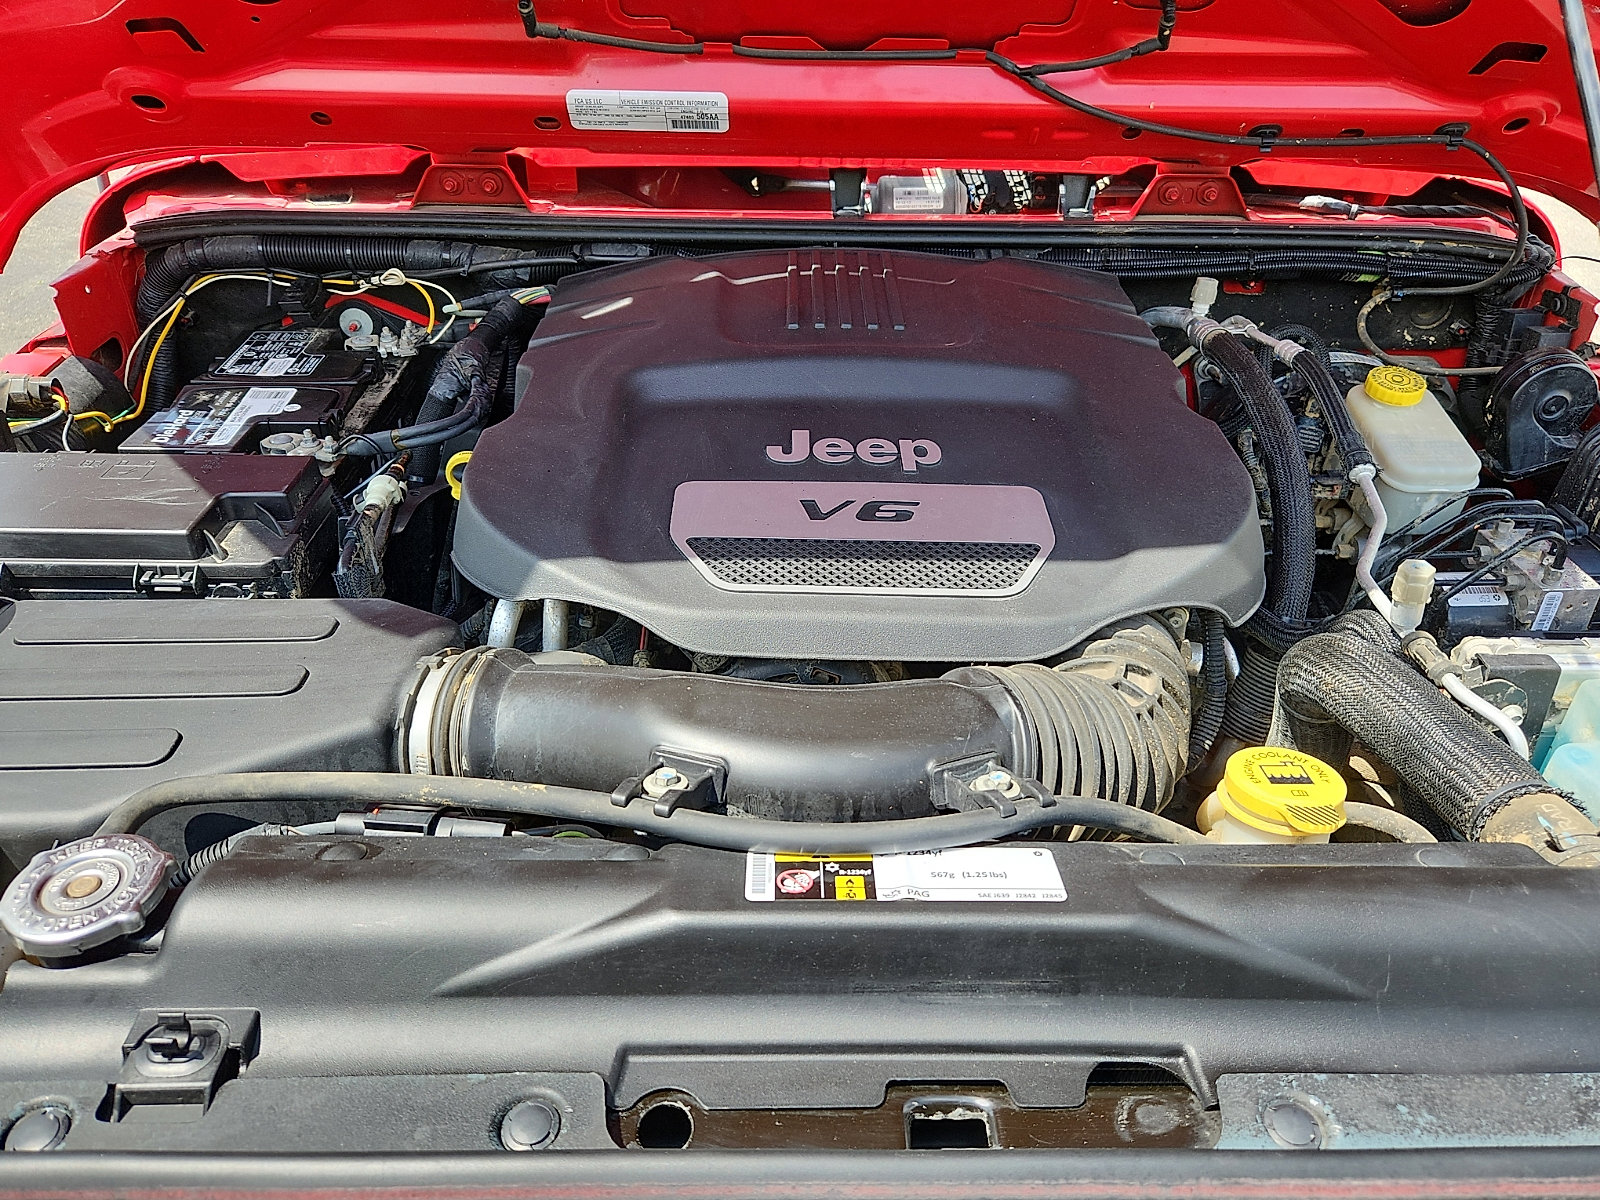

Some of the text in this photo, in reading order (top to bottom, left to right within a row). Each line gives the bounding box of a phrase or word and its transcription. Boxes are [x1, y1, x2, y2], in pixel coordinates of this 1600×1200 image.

[150, 409, 195, 444] DieHard
[766, 429, 942, 472] Jeep
[799, 499, 921, 522] V6
[1244, 751, 1331, 784] ENGINE COOLANT ONLY
[50, 838, 106, 864] KEEP
[930, 871, 955, 879] 567g
[907, 888, 930, 898] PAG
[43, 909, 101, 931] OPEN
